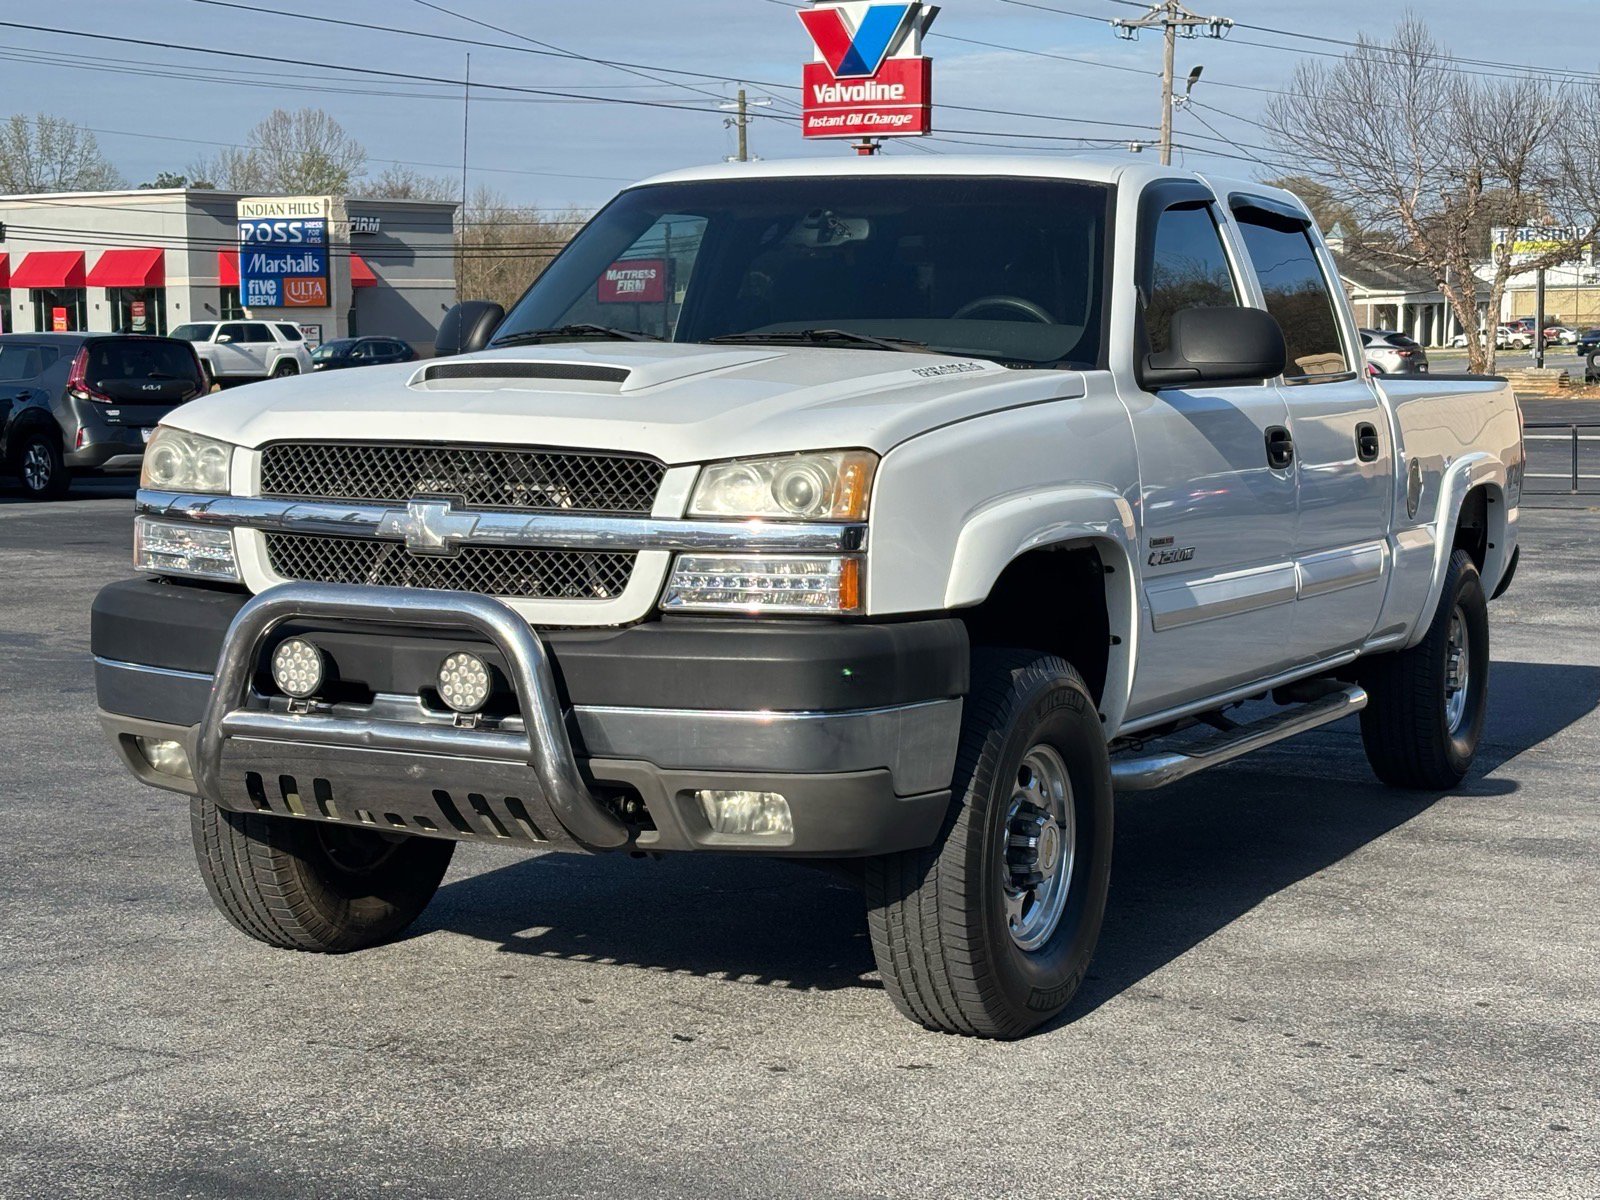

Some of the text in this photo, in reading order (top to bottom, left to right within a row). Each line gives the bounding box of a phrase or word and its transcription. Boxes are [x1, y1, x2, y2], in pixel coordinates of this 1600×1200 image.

[813, 81, 904, 103] Valvoline
[808, 113, 913, 127] Instant Oil Change
[242, 202, 320, 216] INDIAN HILLS
[350, 217, 380, 232] FIRM
[241, 221, 303, 245] ROSS
[1496, 229, 1534, 242] TRE
[247, 252, 320, 273] Marshalls
[606, 269, 656, 280] MATTRESS
[248, 279, 277, 294] five
[290, 281, 323, 295] ULTA
[616, 279, 646, 291] FIRM
[248, 295, 277, 306] BELOW
[301, 327, 317, 335] NC
